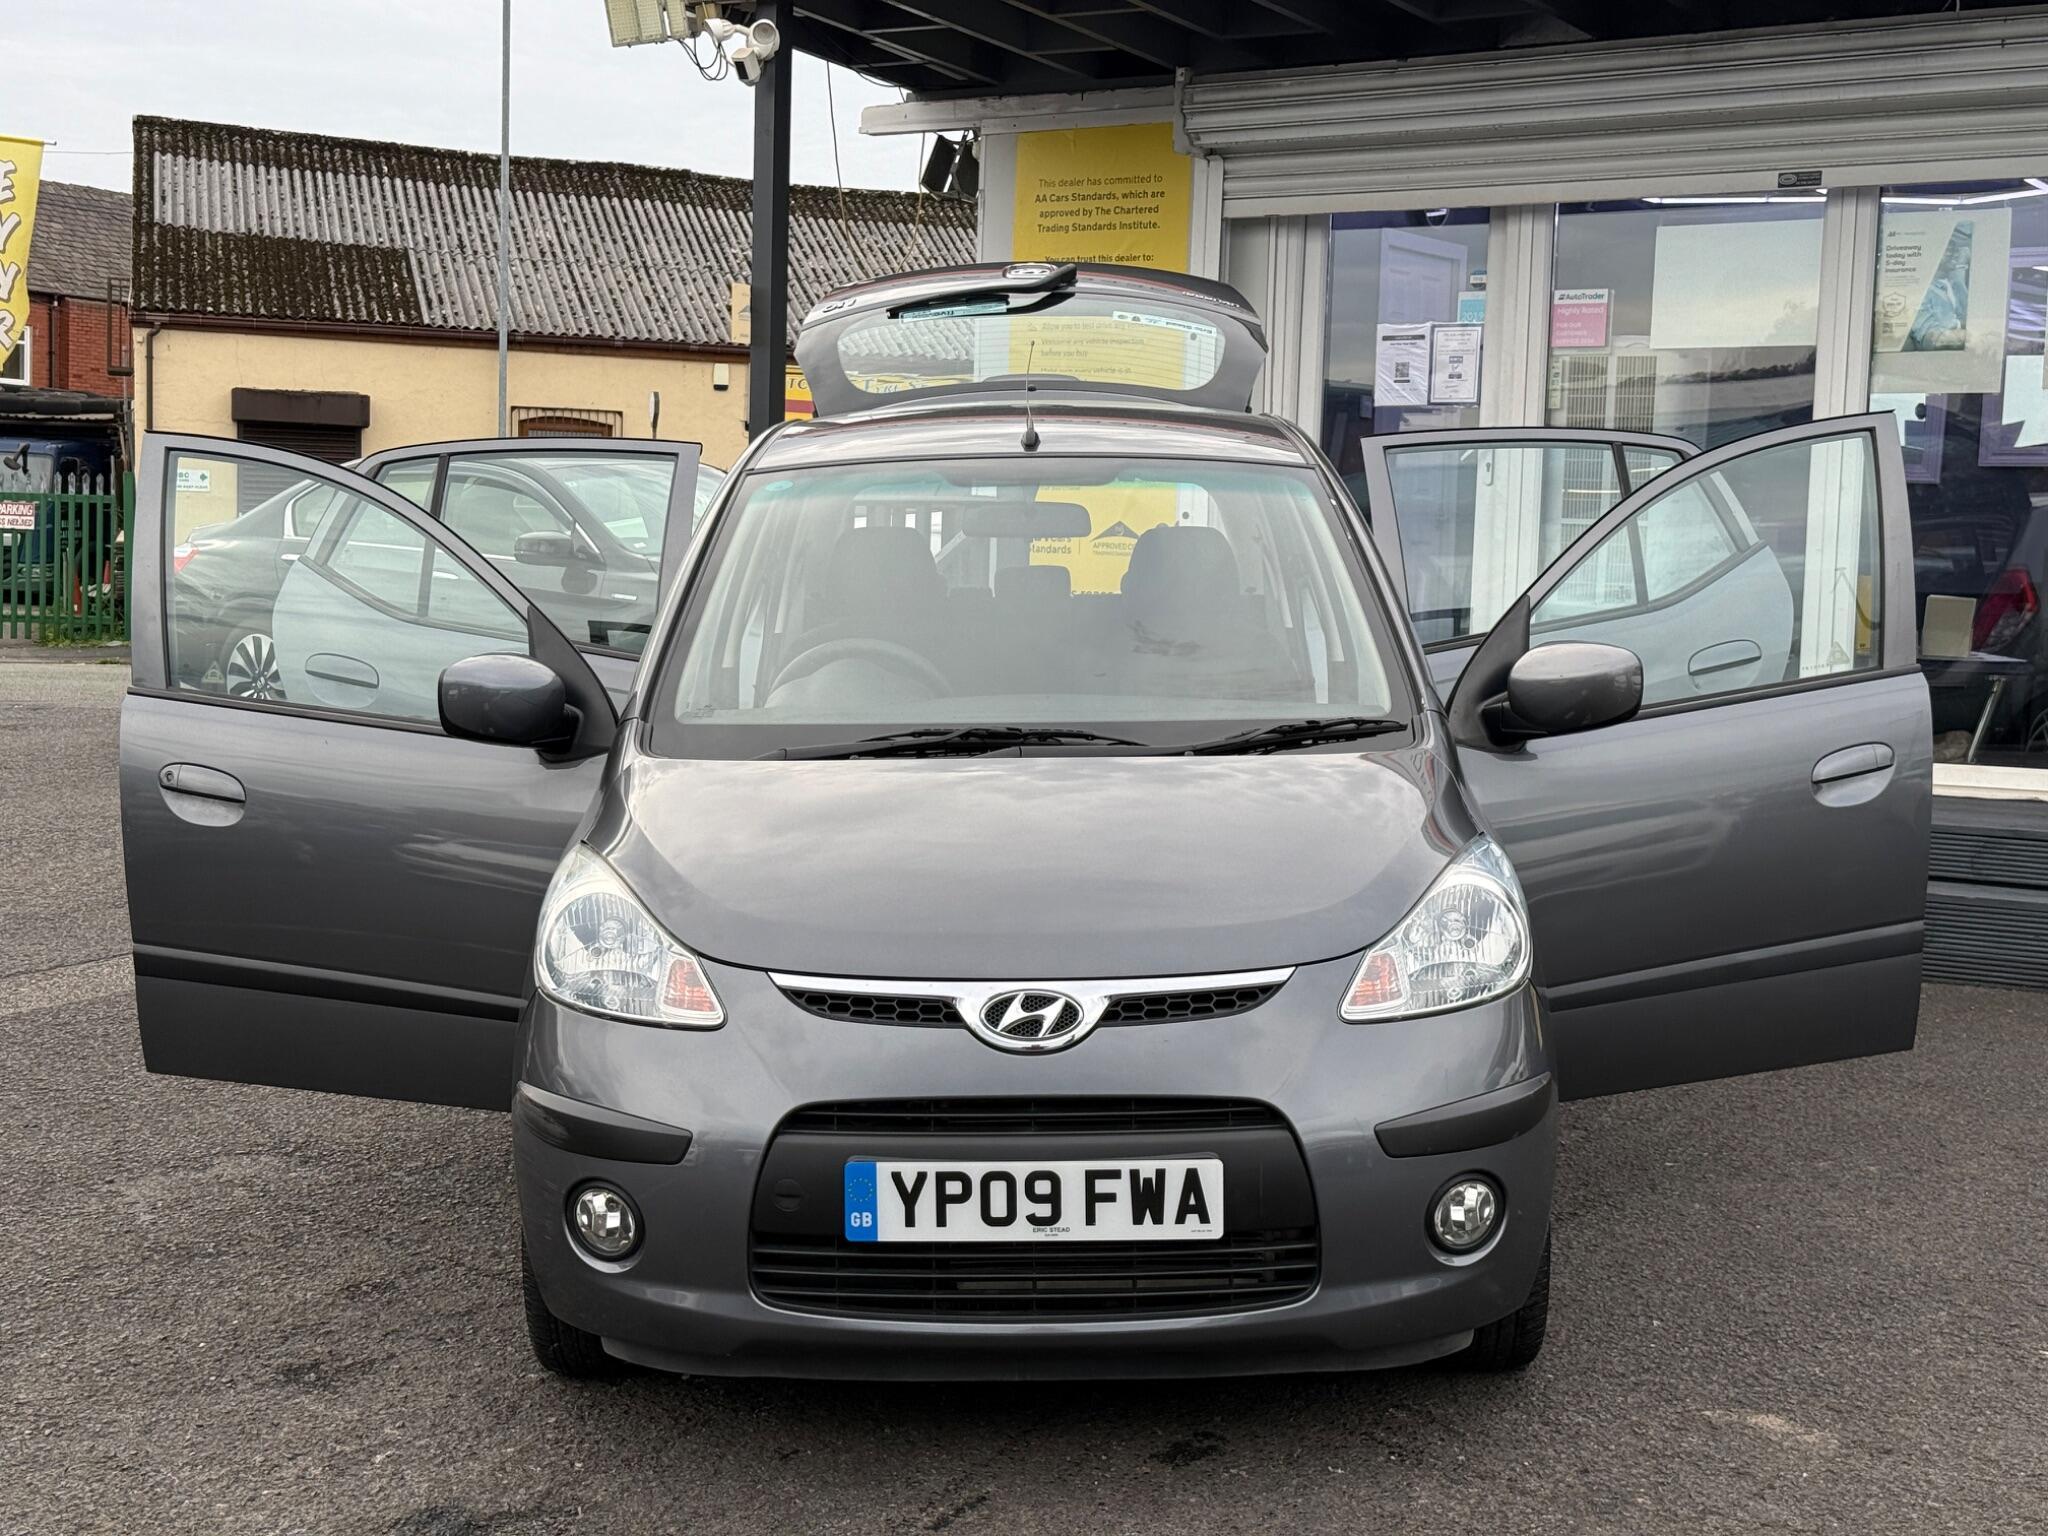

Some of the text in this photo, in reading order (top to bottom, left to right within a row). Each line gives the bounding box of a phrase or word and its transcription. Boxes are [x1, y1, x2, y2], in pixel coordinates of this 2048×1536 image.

[1039, 174, 1163, 188] This dealer has committed to
[1035, 190, 1165, 204] AA Cars Standards, which are
[1039, 205, 1160, 219] approved by The Chartered
[1037, 220, 1161, 234] Trading Standards Institute.
[1098, 254, 1112, 262] this
[1114, 254, 1141, 262] dealer
[1142, 253, 1154, 262] to:
[1030, 544, 1071, 554] tandards
[891, 1168, 1211, 1228] YP09 FWA
[850, 1212, 873, 1227] GB
